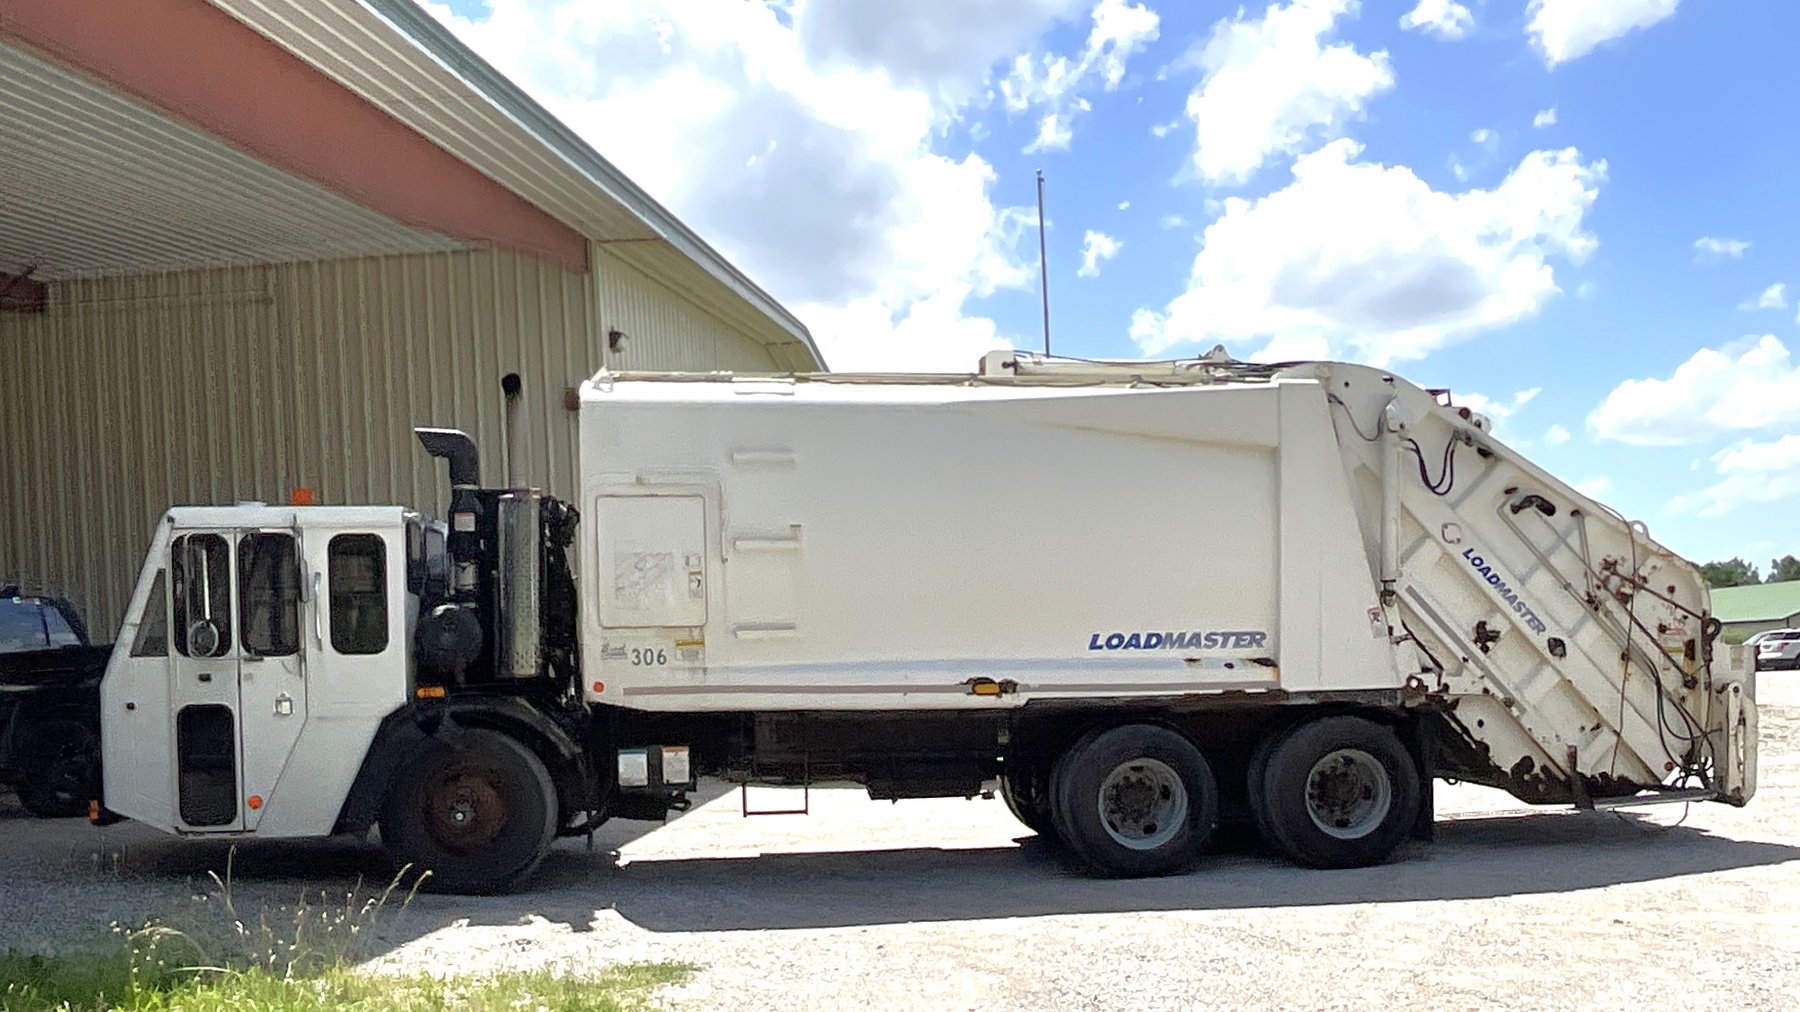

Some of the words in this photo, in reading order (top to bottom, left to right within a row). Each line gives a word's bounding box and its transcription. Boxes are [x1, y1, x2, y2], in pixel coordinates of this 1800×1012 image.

[1462, 547, 1547, 637] LOADMASTER
[1088, 631, 1267, 650] LOADMASTER
[631, 648, 667, 666] 306
